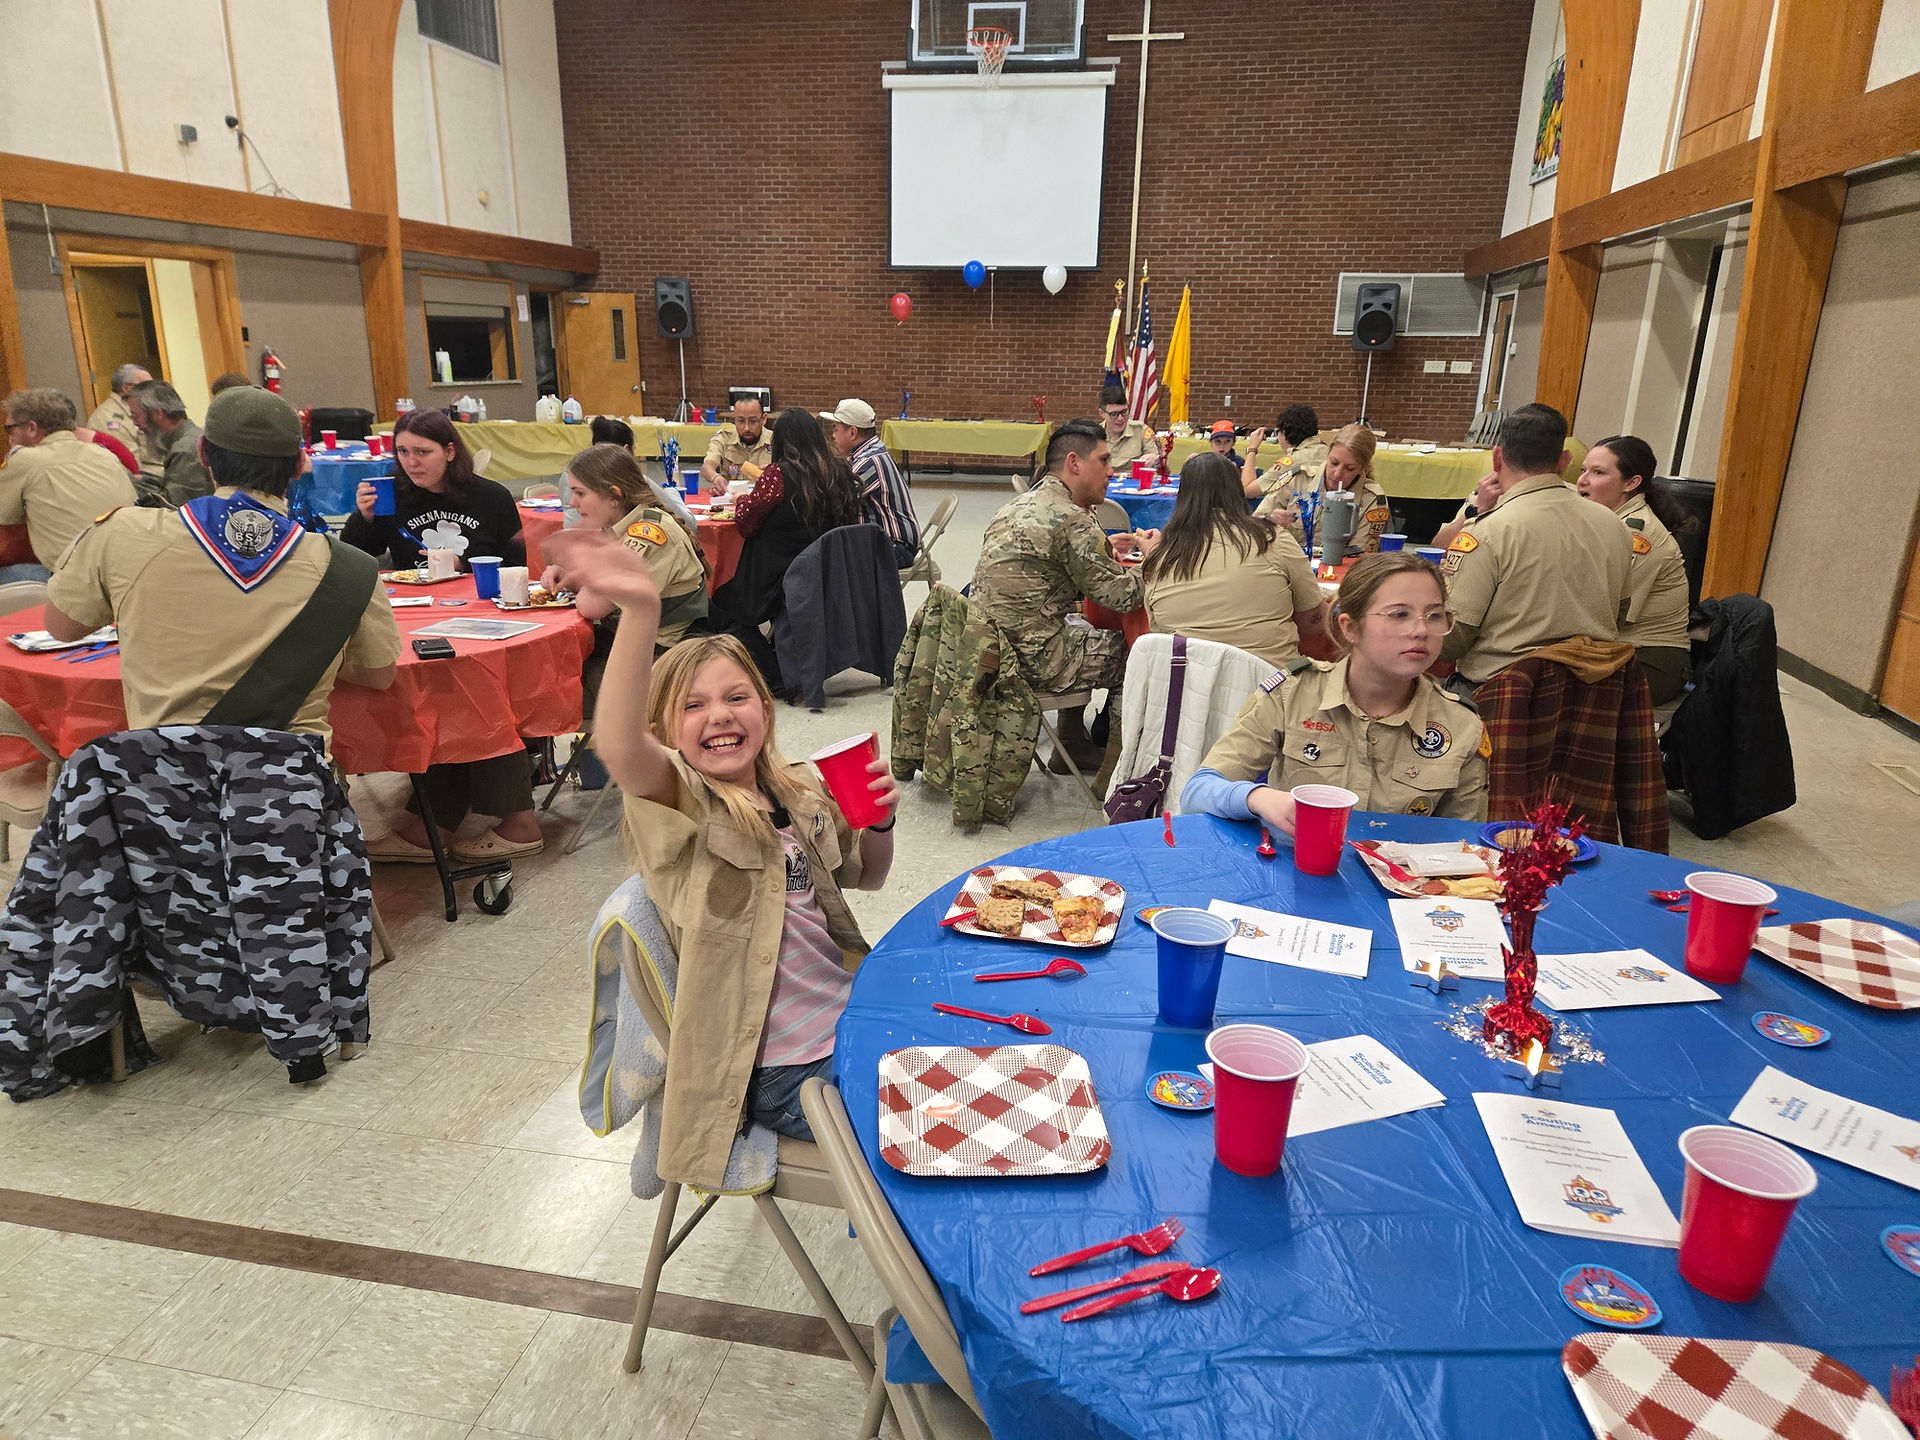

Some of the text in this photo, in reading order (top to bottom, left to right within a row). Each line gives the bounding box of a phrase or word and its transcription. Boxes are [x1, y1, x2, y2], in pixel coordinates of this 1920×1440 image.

[407, 510, 480, 529] SHENANIGANS
[235, 532, 262, 543] BSA
[624, 539, 646, 552] 427
[1316, 722, 1336, 733] BSA
[1350, 1055, 1384, 1085] America
[1356, 1052, 1392, 1084] Scouting
[1521, 1113, 1582, 1129] Scouting
[1526, 1119, 1582, 1133] America
[1566, 1185, 1608, 1201] 100
